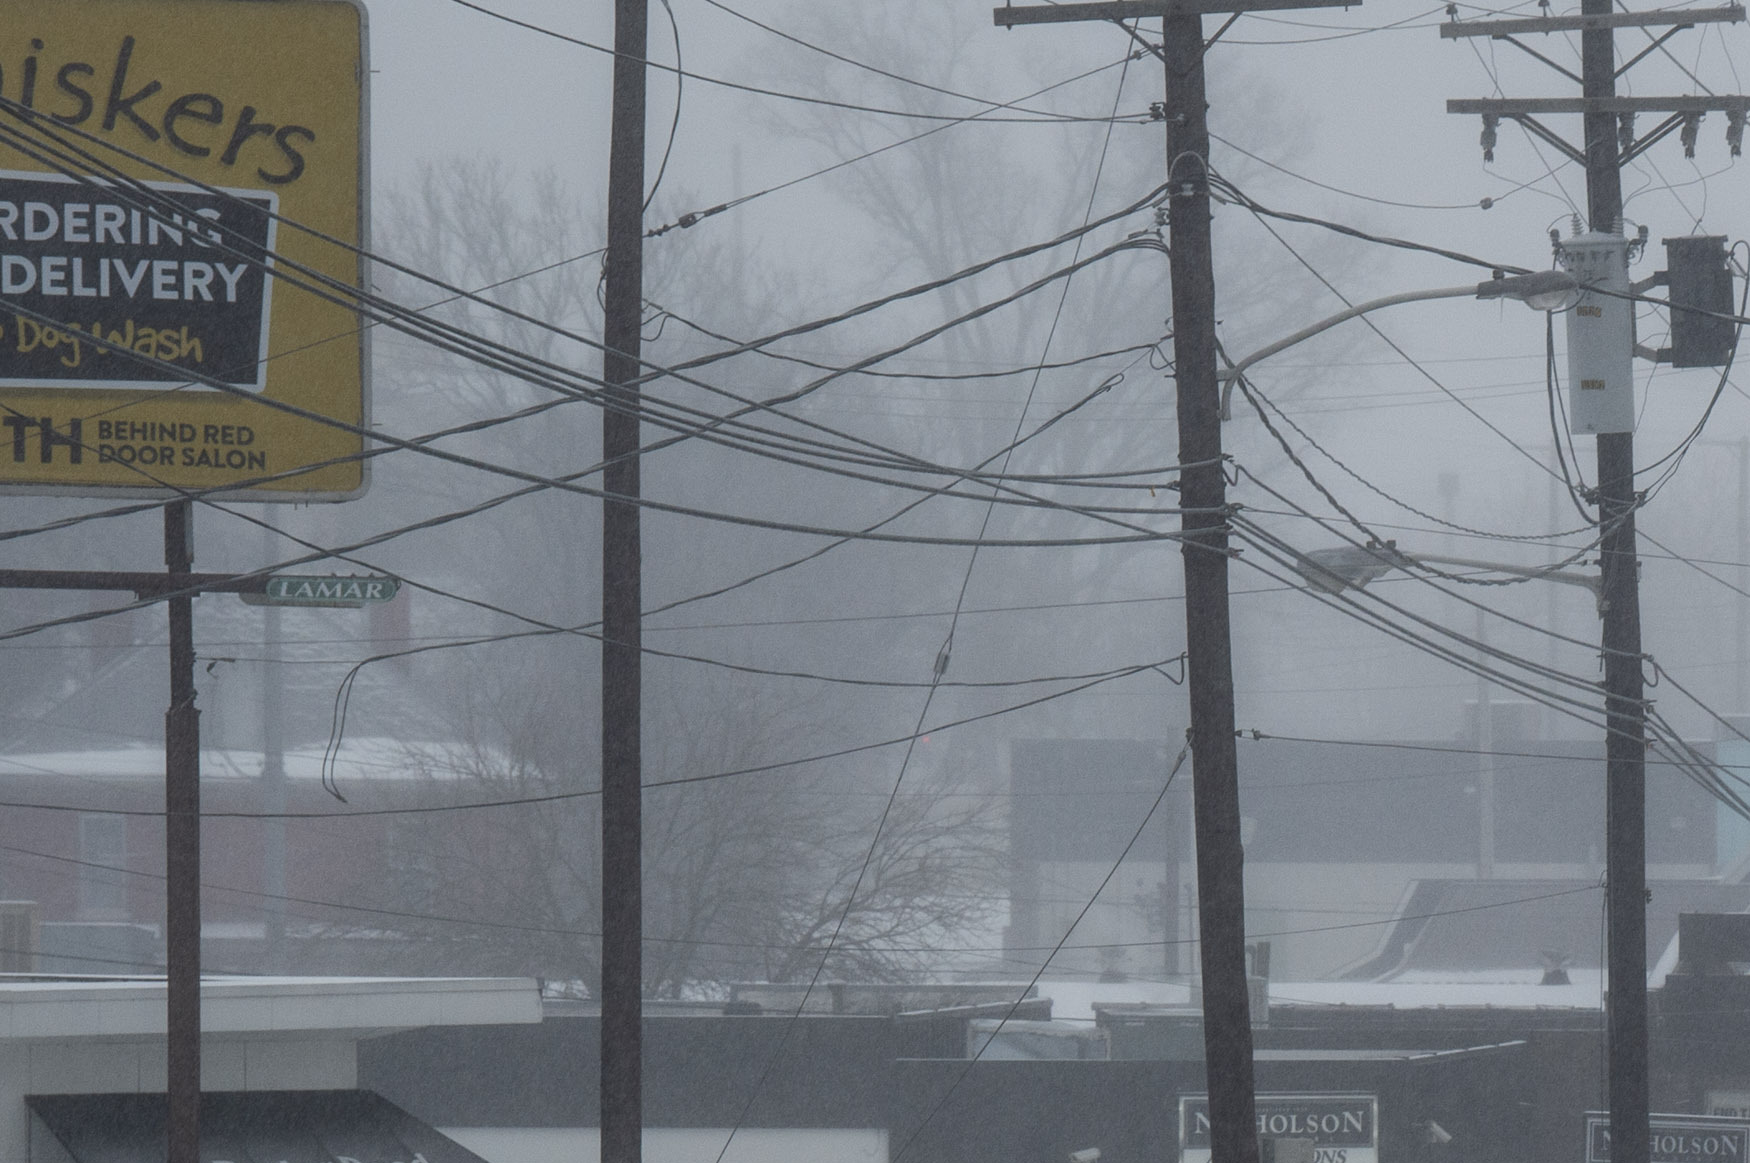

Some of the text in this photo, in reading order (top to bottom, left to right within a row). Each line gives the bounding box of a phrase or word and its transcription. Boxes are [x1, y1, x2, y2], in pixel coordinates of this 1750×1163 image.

[0, 35, 316, 185] iskers
[1, 255, 248, 302] DELIVERY
[16, 314, 203, 367] Dog Wash
[98, 420, 255, 446] BEHIND RED
[99, 444, 266, 471] DOOR SALON
[280, 581, 382, 598] LAMAR
[1195, 1111, 1364, 1134] NHOLSON
[1603, 1131, 1738, 1155] NHOLSON
